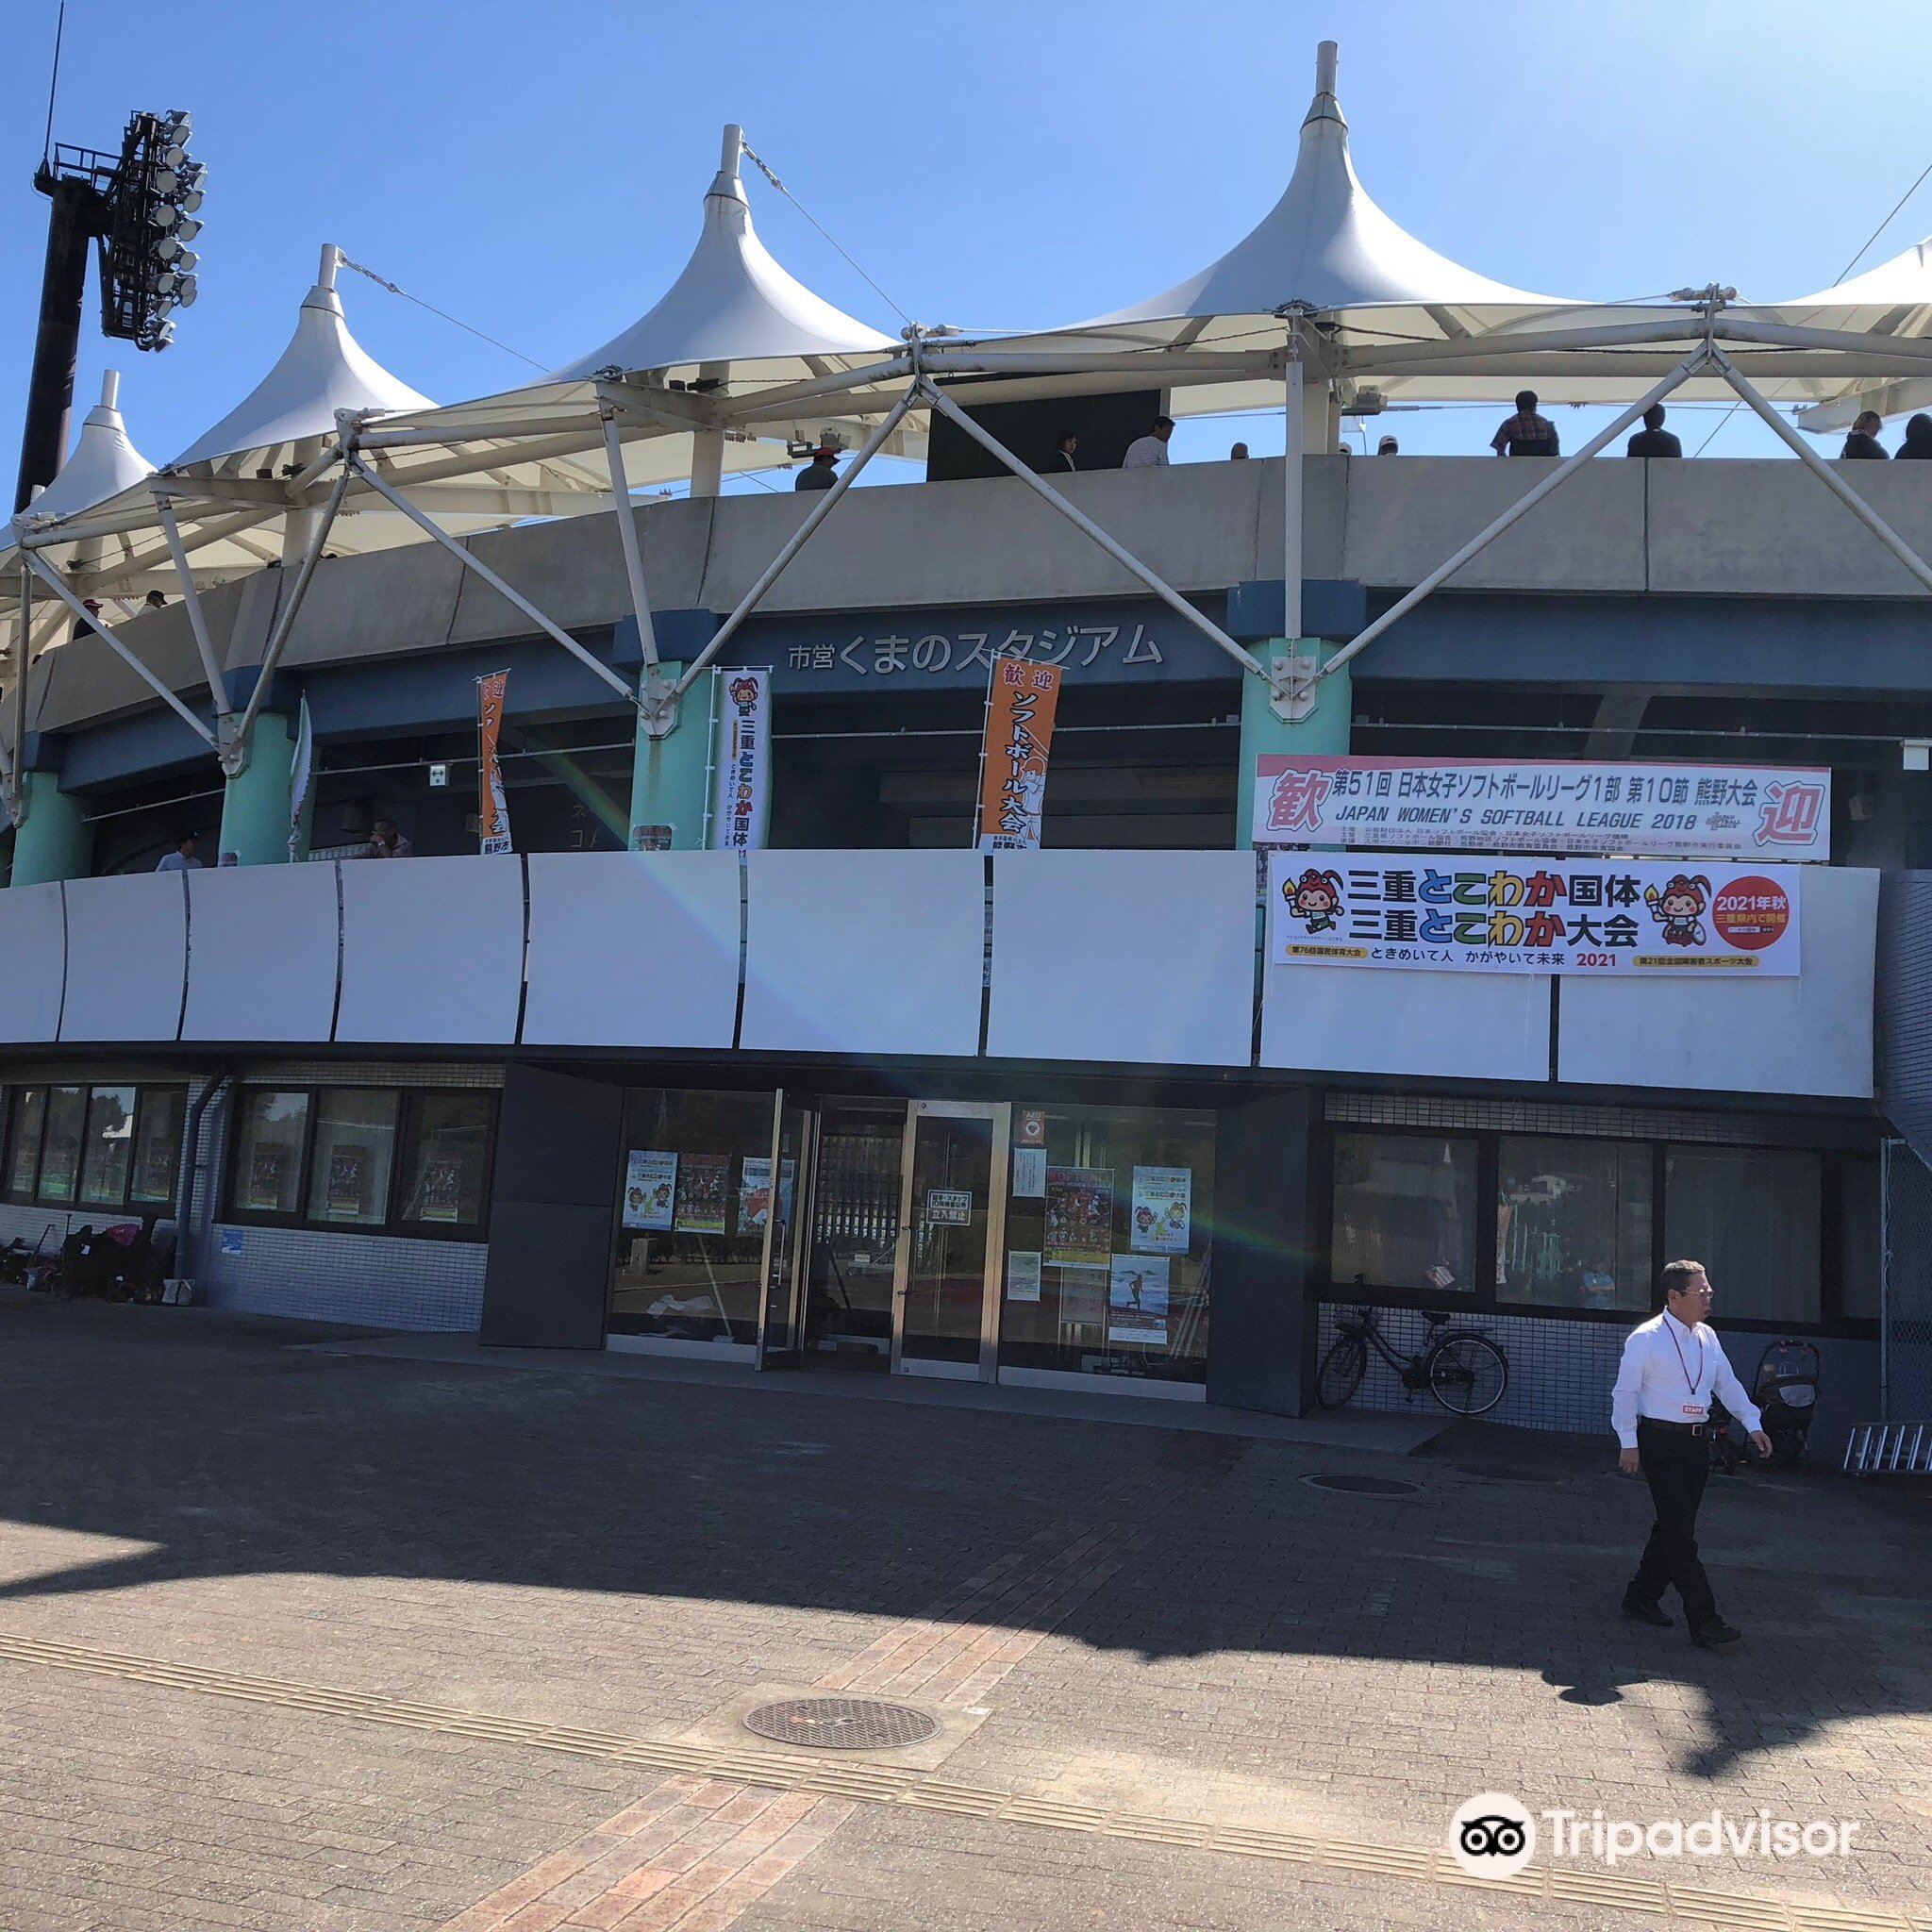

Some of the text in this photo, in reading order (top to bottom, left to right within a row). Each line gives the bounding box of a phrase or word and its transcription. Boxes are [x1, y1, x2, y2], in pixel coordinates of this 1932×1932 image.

[1003, 662, 1054, 691] 歓迎
[999, 691, 1038, 834] ソフトボール大会
[733, 719, 757, 847] 三重とこわか国体
[1268, 770, 1331, 830] 歓
[1332, 770, 1758, 807] 第51回 日本女子ソフトボールリーグ1部 第10節 熊野大会
[1336, 806, 1390, 822] JAPAN
[1480, 809, 1564, 826] SOFTBALL
[1576, 811, 1643, 829] LEAGUE
[1652, 813, 1698, 830] 2018
[1755, 783, 1824, 844] 迎
[1347, 869, 1641, 908] 三重とこわか国体
[1716, 895, 1787, 911] 2021年秋
[1348, 908, 1640, 948] 三重とこわか大会
[1291, 946, 1361, 957] 第76回国民体育大会
[1371, 947, 1617, 967] ときめいて人 かがやいて未来 2021
